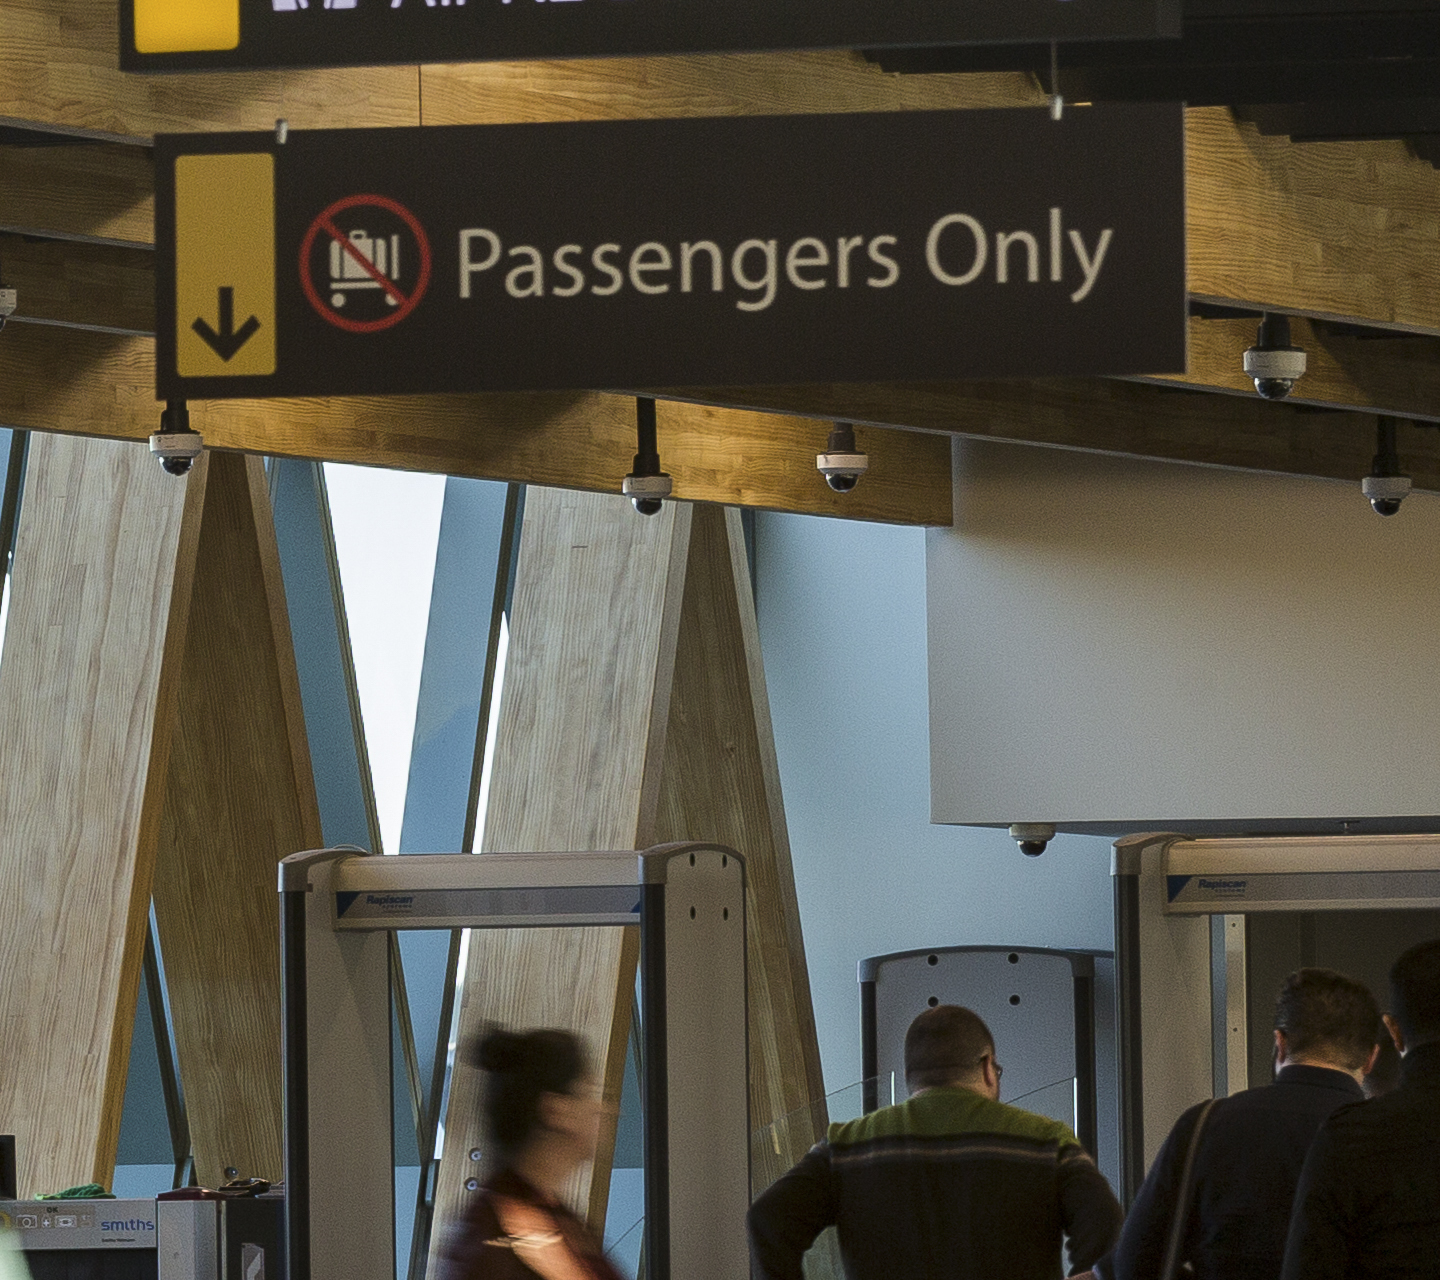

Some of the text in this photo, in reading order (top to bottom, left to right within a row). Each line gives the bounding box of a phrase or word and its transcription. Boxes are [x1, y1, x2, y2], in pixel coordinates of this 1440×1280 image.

[459, 207, 1113, 312] Passengers Only
[101, 1219, 155, 1231] smiths
